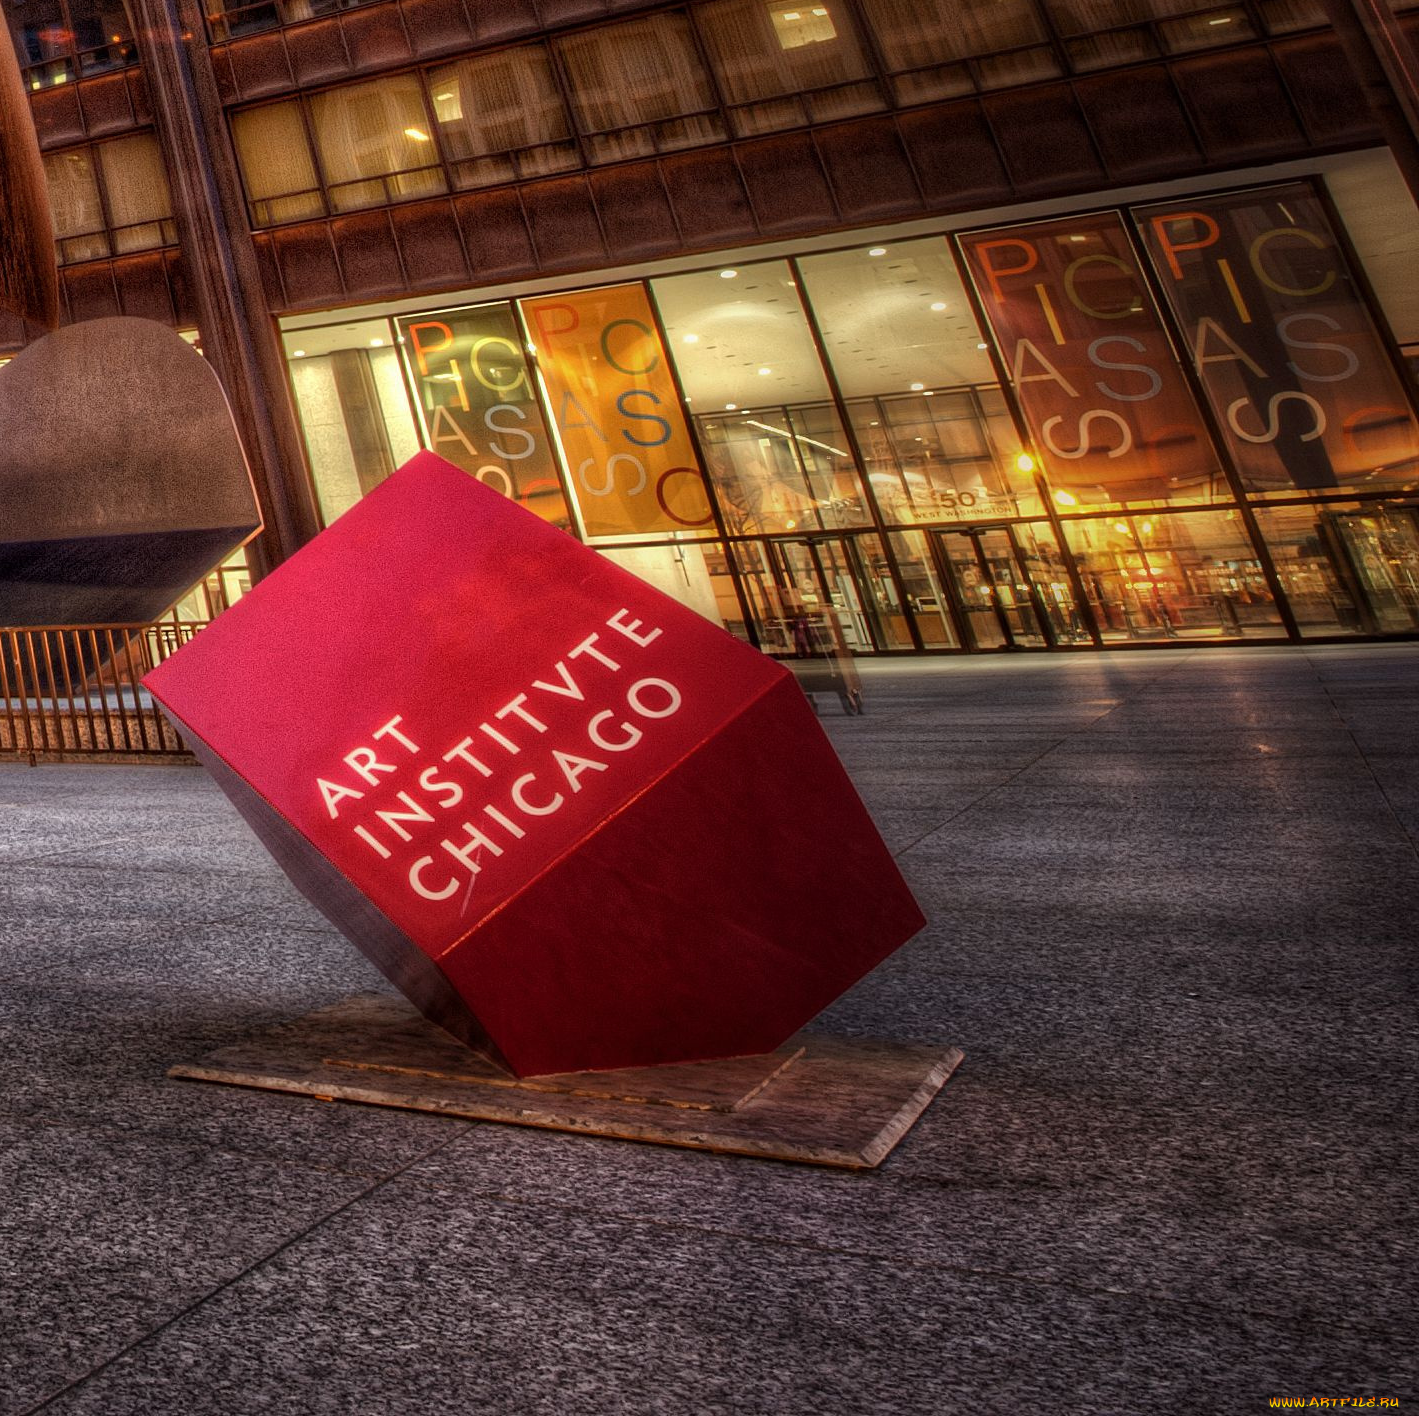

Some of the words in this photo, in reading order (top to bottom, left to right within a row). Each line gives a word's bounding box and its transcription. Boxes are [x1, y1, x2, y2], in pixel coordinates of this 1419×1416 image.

[913, 510, 941, 520] WEST
[945, 506, 1012, 518] WASHINGTON
[940, 491, 976, 509] 50
[315, 715, 423, 821] ART
[353, 607, 663, 860] INSTITVTE
[408, 676, 682, 902] CHICAGO
